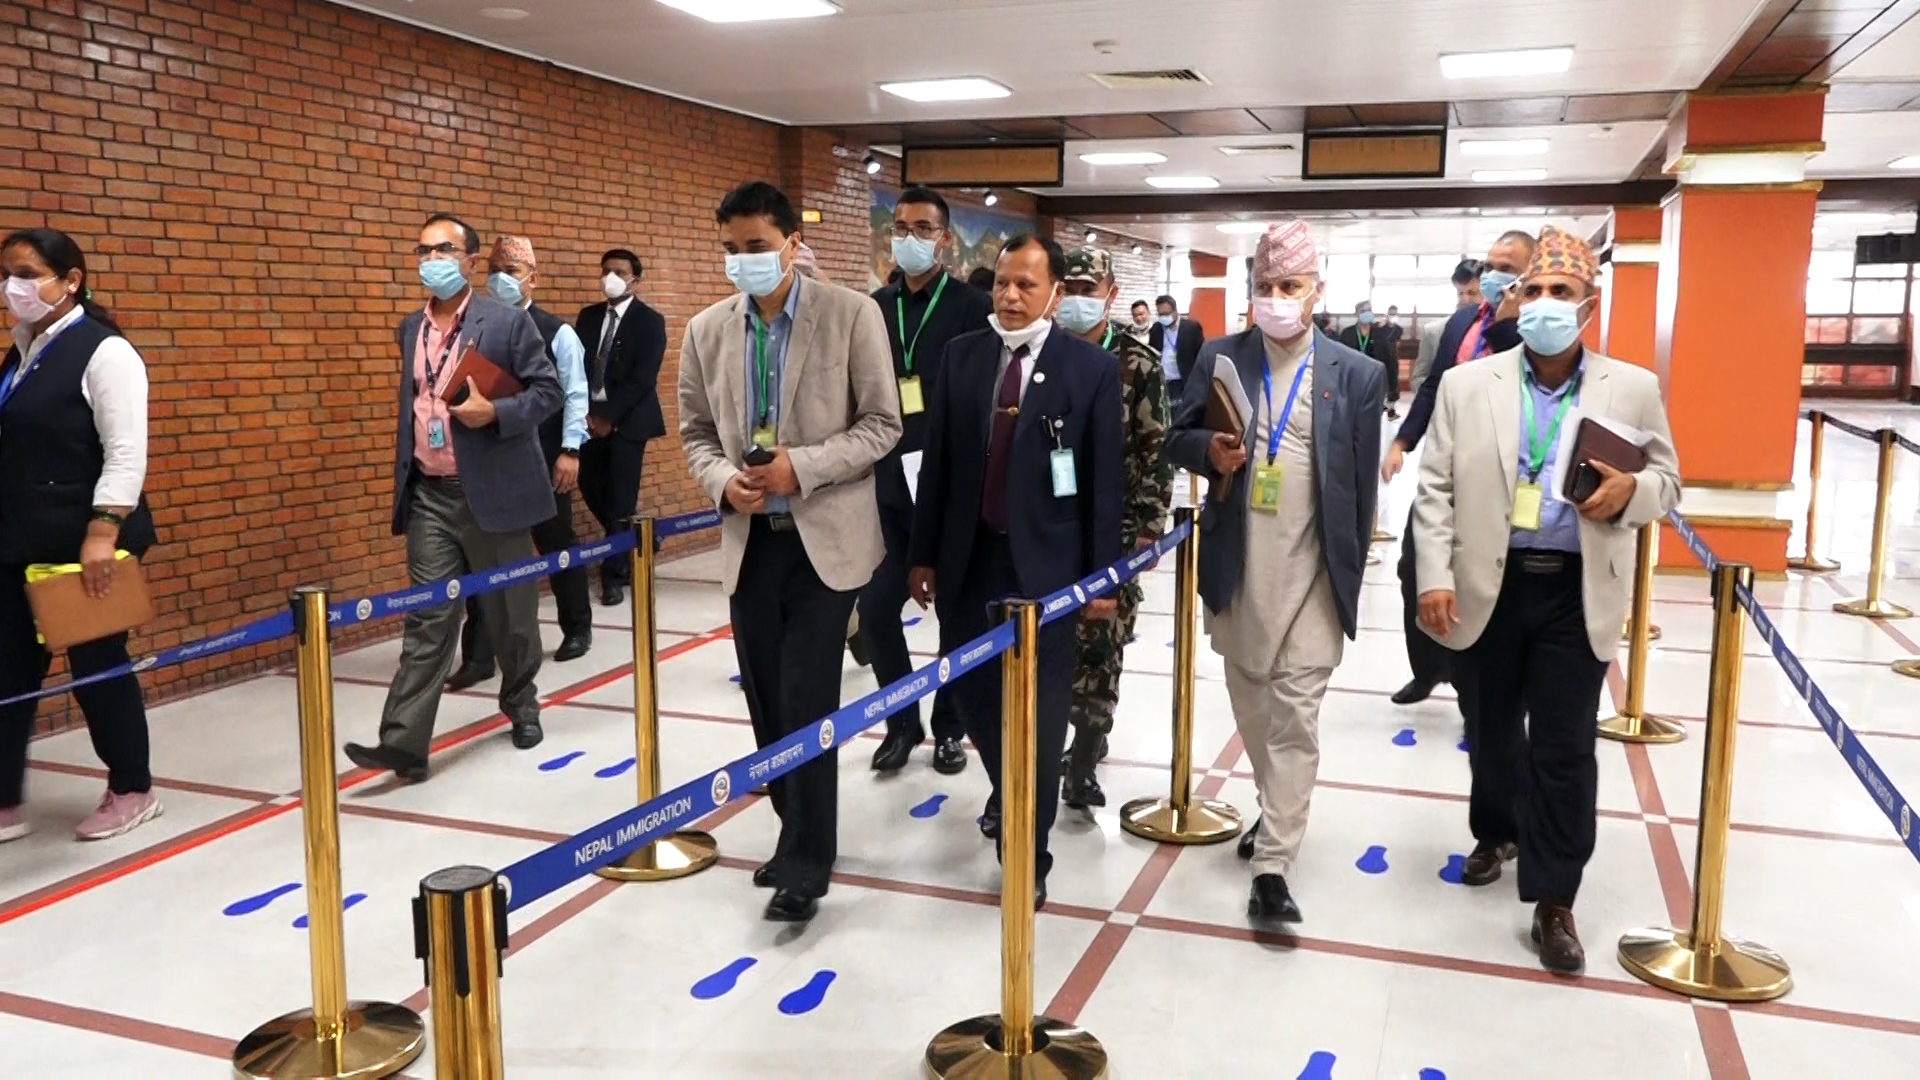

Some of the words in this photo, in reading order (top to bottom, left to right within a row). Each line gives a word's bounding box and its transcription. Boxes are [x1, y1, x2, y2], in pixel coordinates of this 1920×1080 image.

[864, 697, 886, 720] NEPAL
[886, 675, 929, 707] IMMIGRATION
[574, 835, 614, 867] NEPAL
[616, 796, 692, 846] IMMIGRATION
